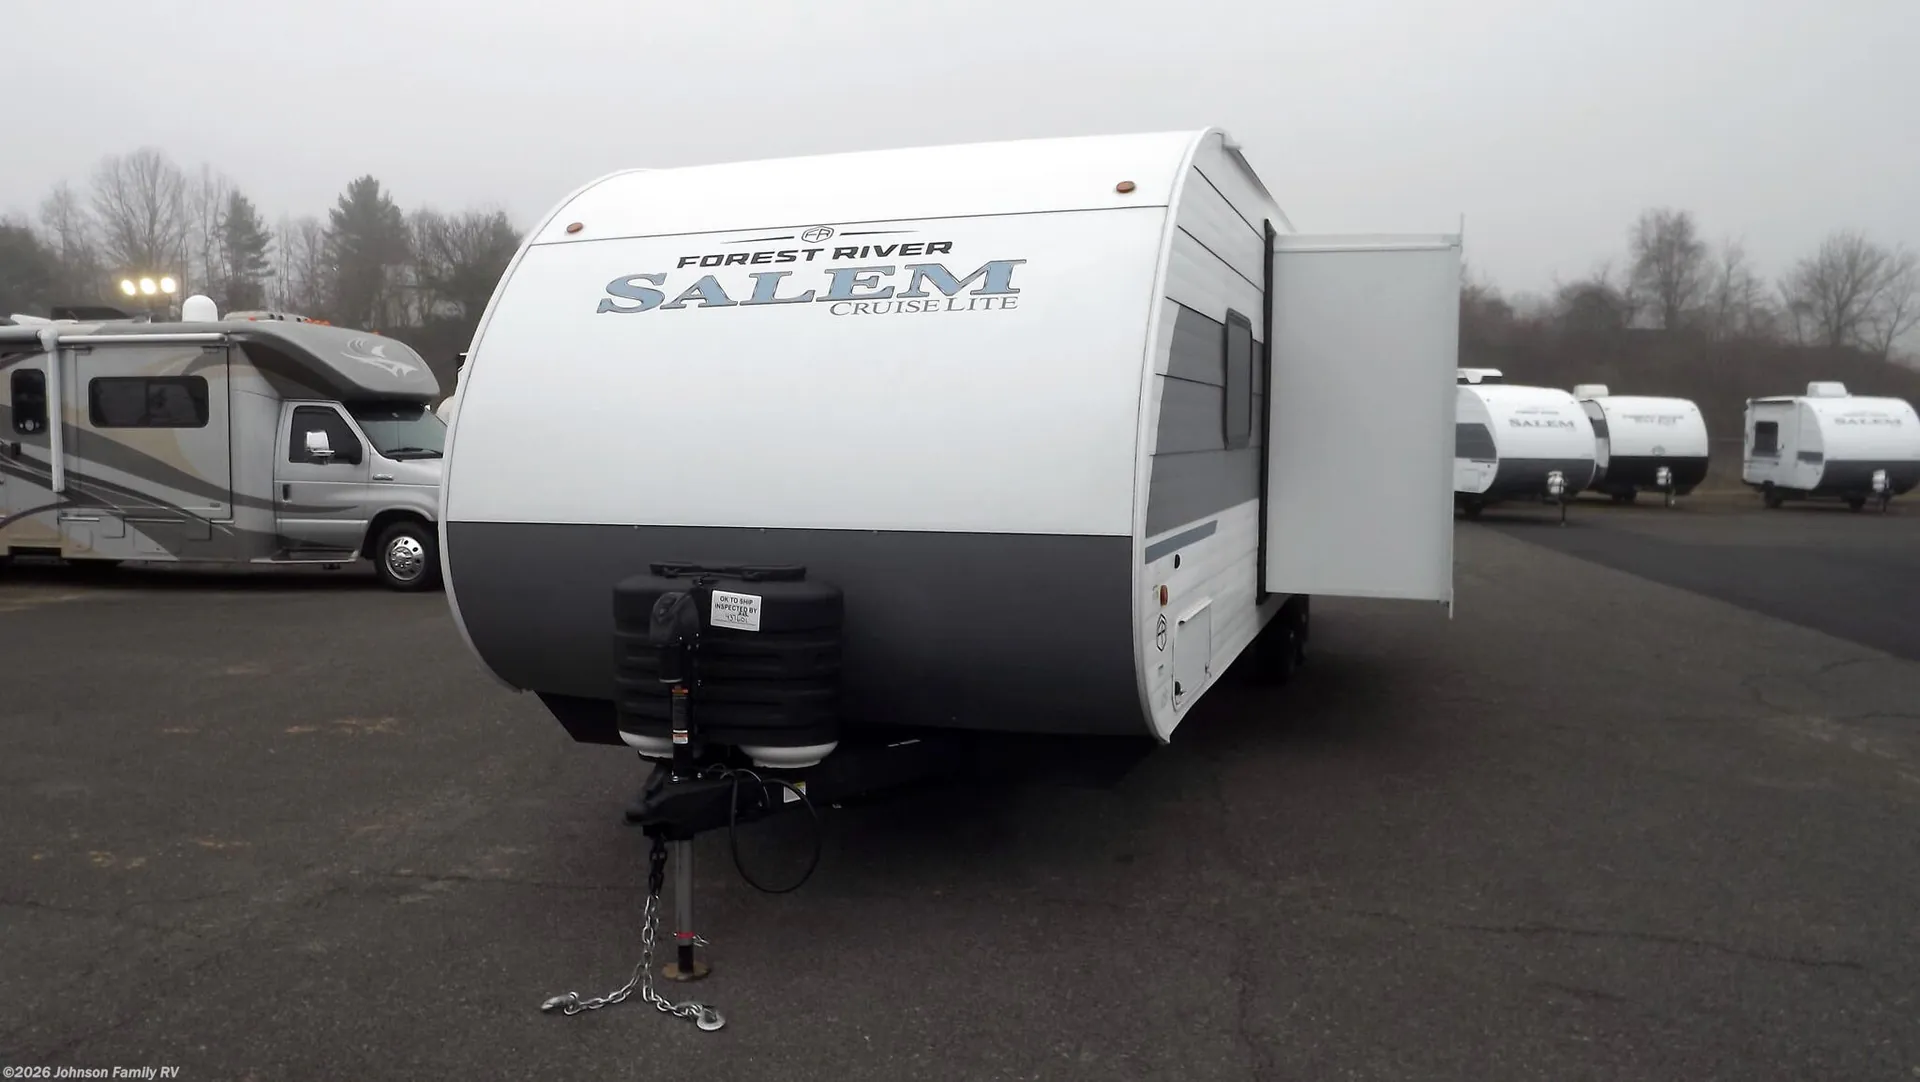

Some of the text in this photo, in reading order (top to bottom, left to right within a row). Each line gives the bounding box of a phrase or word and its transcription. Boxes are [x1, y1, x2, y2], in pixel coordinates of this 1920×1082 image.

[677, 241, 953, 269] FOREST RIVER
[597, 259, 1027, 314] SALEM
[1508, 419, 1575, 429] SALEM
[715, 603, 748, 612] INSPECTED
